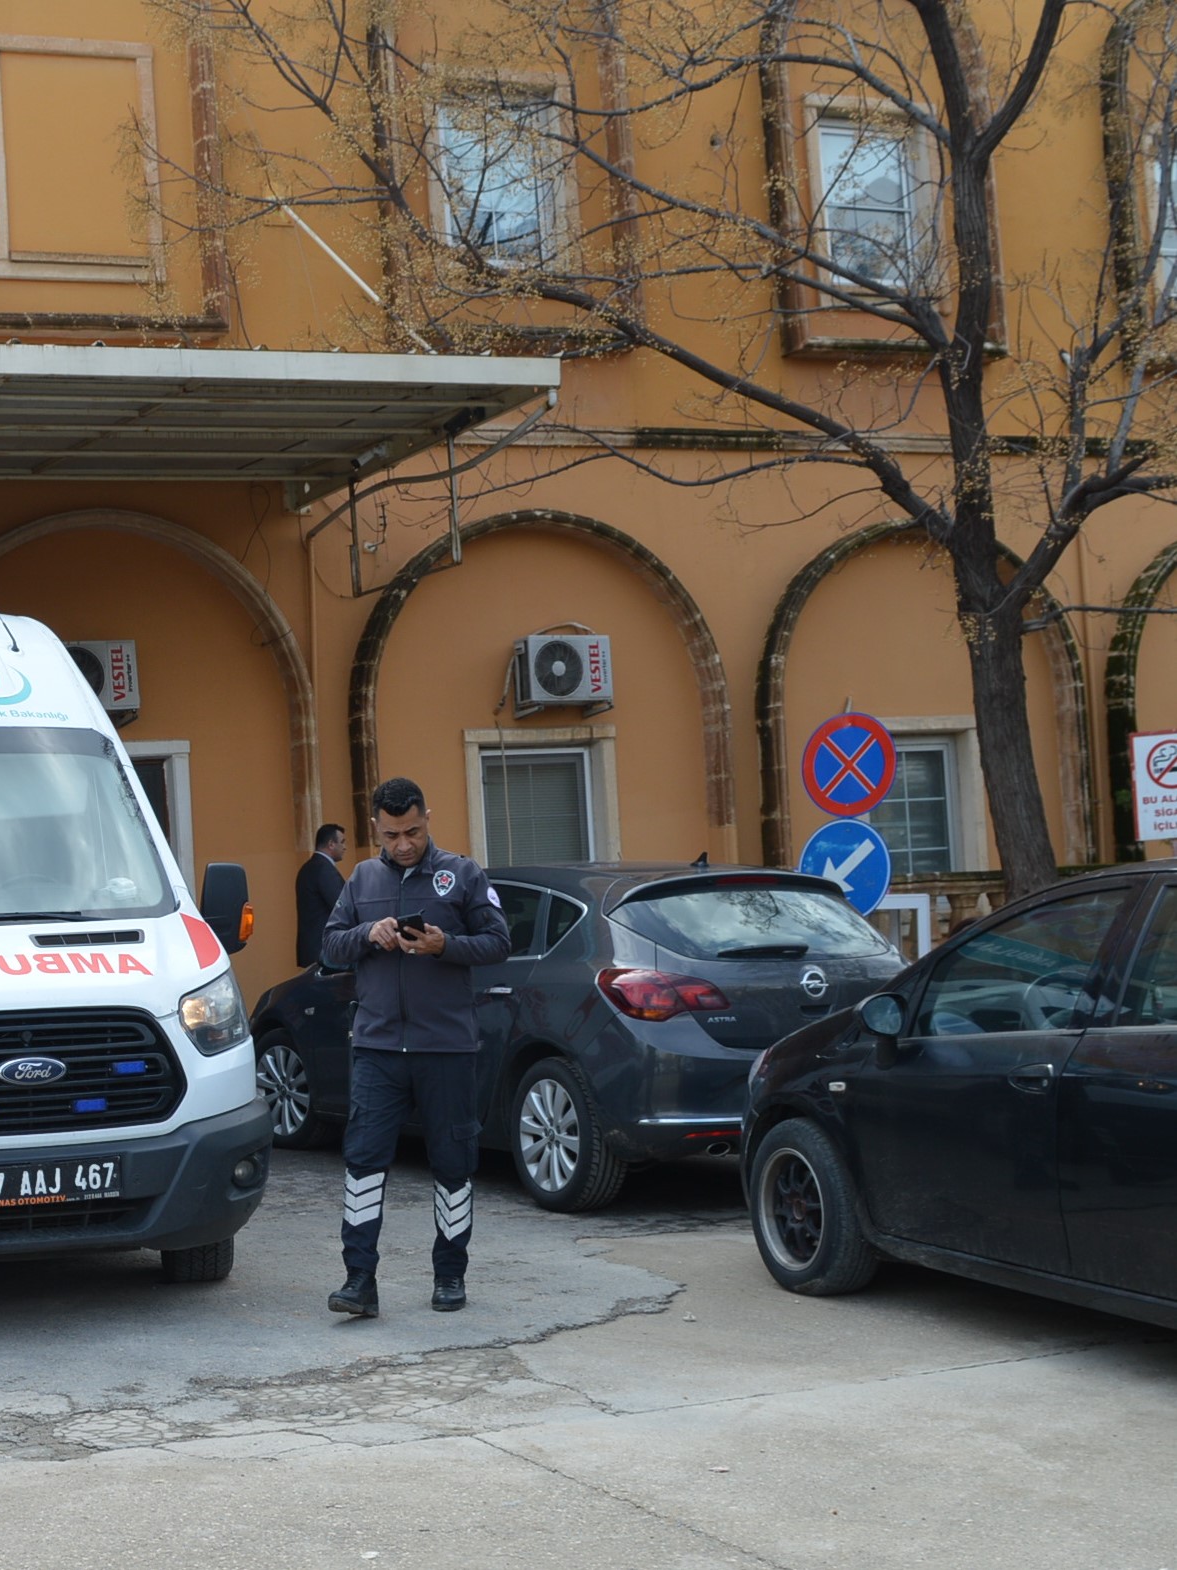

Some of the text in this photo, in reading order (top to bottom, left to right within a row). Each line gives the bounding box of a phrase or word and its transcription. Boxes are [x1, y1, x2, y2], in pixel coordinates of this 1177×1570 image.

[110, 645, 126, 702] VESTEL
[588, 640, 602, 693] VESTEL
[9, 709, 70, 722] Bakanlığı
[1142, 796, 1158, 805] BU
[14, 1062, 52, 1080] Ford
[20, 1167, 61, 1196] AAJ
[74, 1162, 115, 1190] 467
